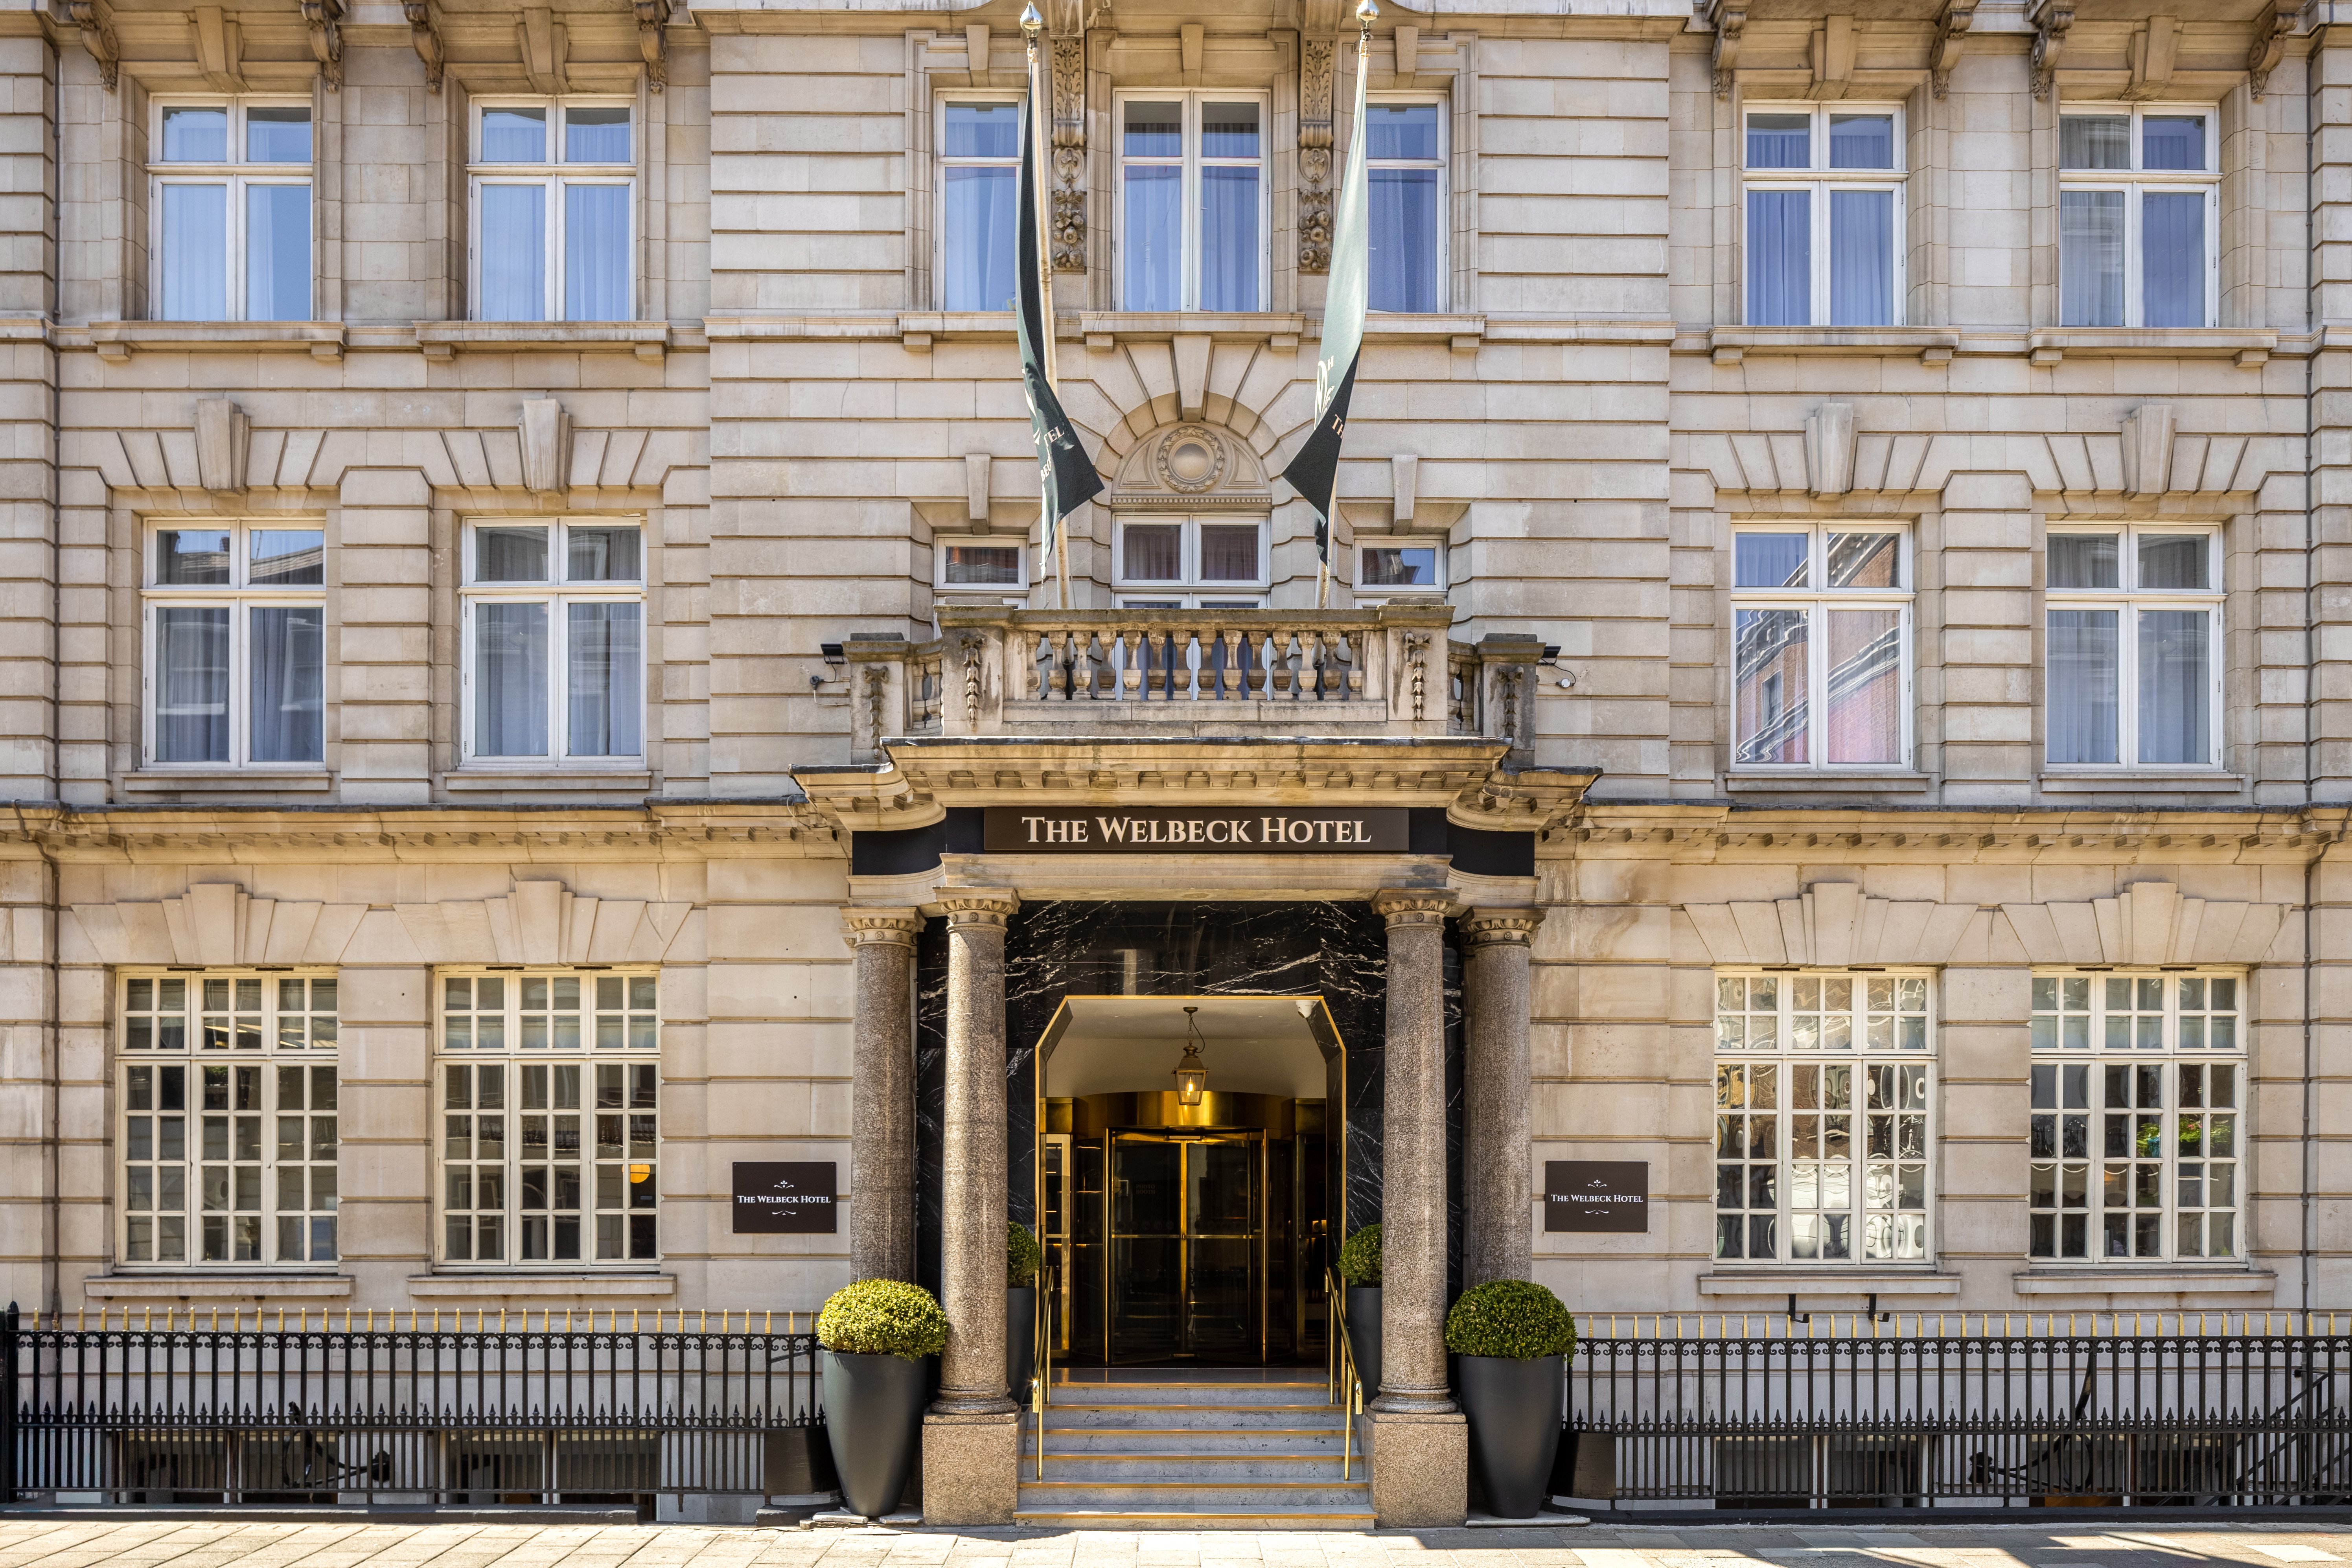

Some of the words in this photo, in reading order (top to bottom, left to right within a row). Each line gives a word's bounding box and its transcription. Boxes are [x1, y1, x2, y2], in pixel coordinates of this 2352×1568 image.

[1022, 817, 1089, 842] THE
[1095, 817, 1252, 843] WELBECK
[1260, 817, 1371, 843] HOTEL
